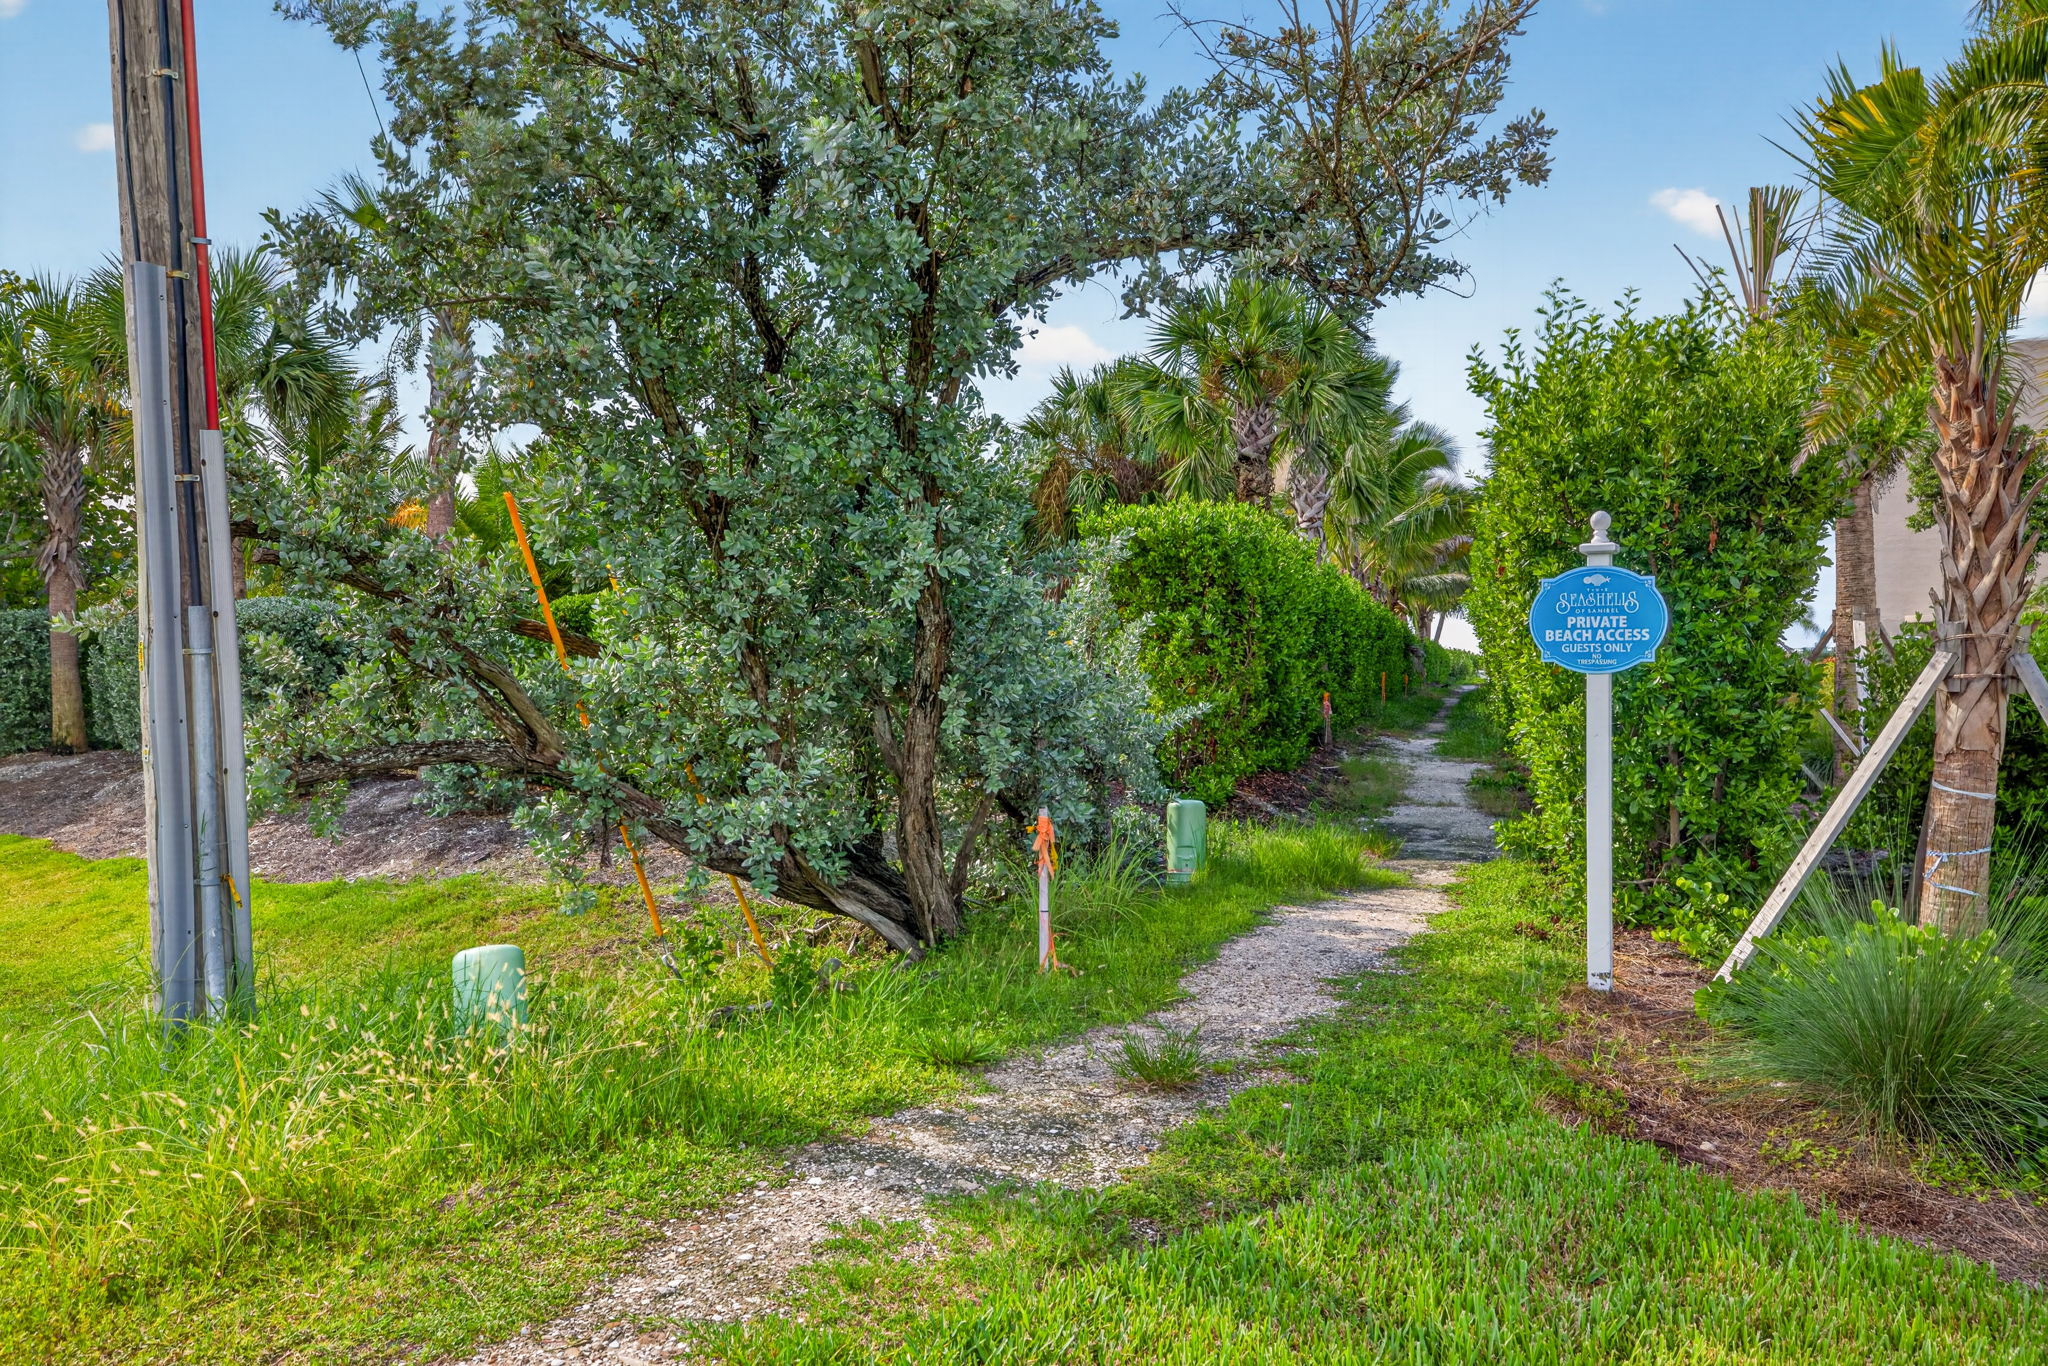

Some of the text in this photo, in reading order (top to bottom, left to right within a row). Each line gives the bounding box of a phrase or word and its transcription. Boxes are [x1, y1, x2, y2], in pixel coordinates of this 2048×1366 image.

[1556, 591, 1639, 614] SEASHELLS
[1567, 616, 1627, 628] PRIVATE
[1545, 629, 1650, 642] BEACH ACCESS
[1561, 643, 1632, 653] GUESTS ONLY
